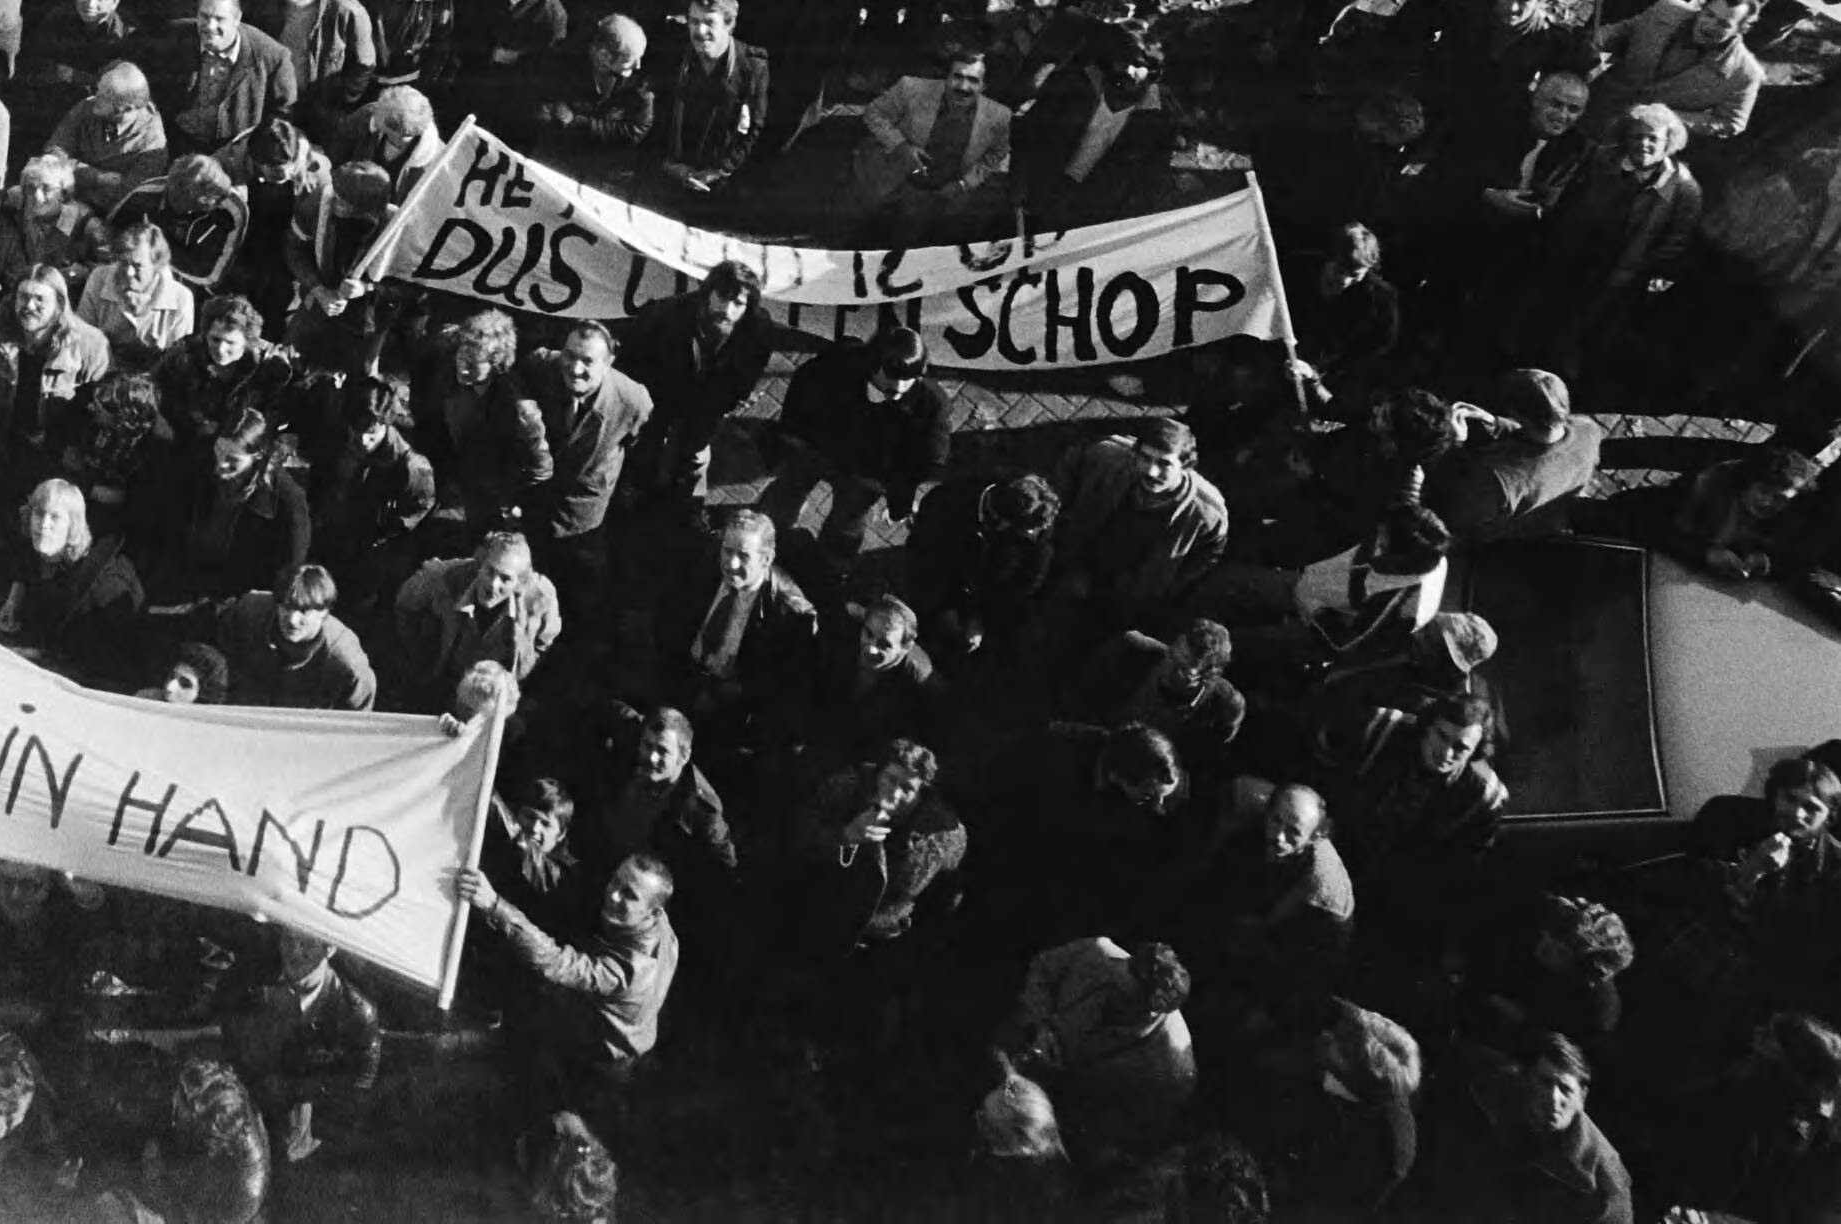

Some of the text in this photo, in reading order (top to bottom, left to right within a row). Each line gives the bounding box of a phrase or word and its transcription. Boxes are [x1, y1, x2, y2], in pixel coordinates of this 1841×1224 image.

[411, 217, 599, 313] DUS
[943, 265, 1246, 366] SCHOP
[107, 770, 400, 919] HAND
